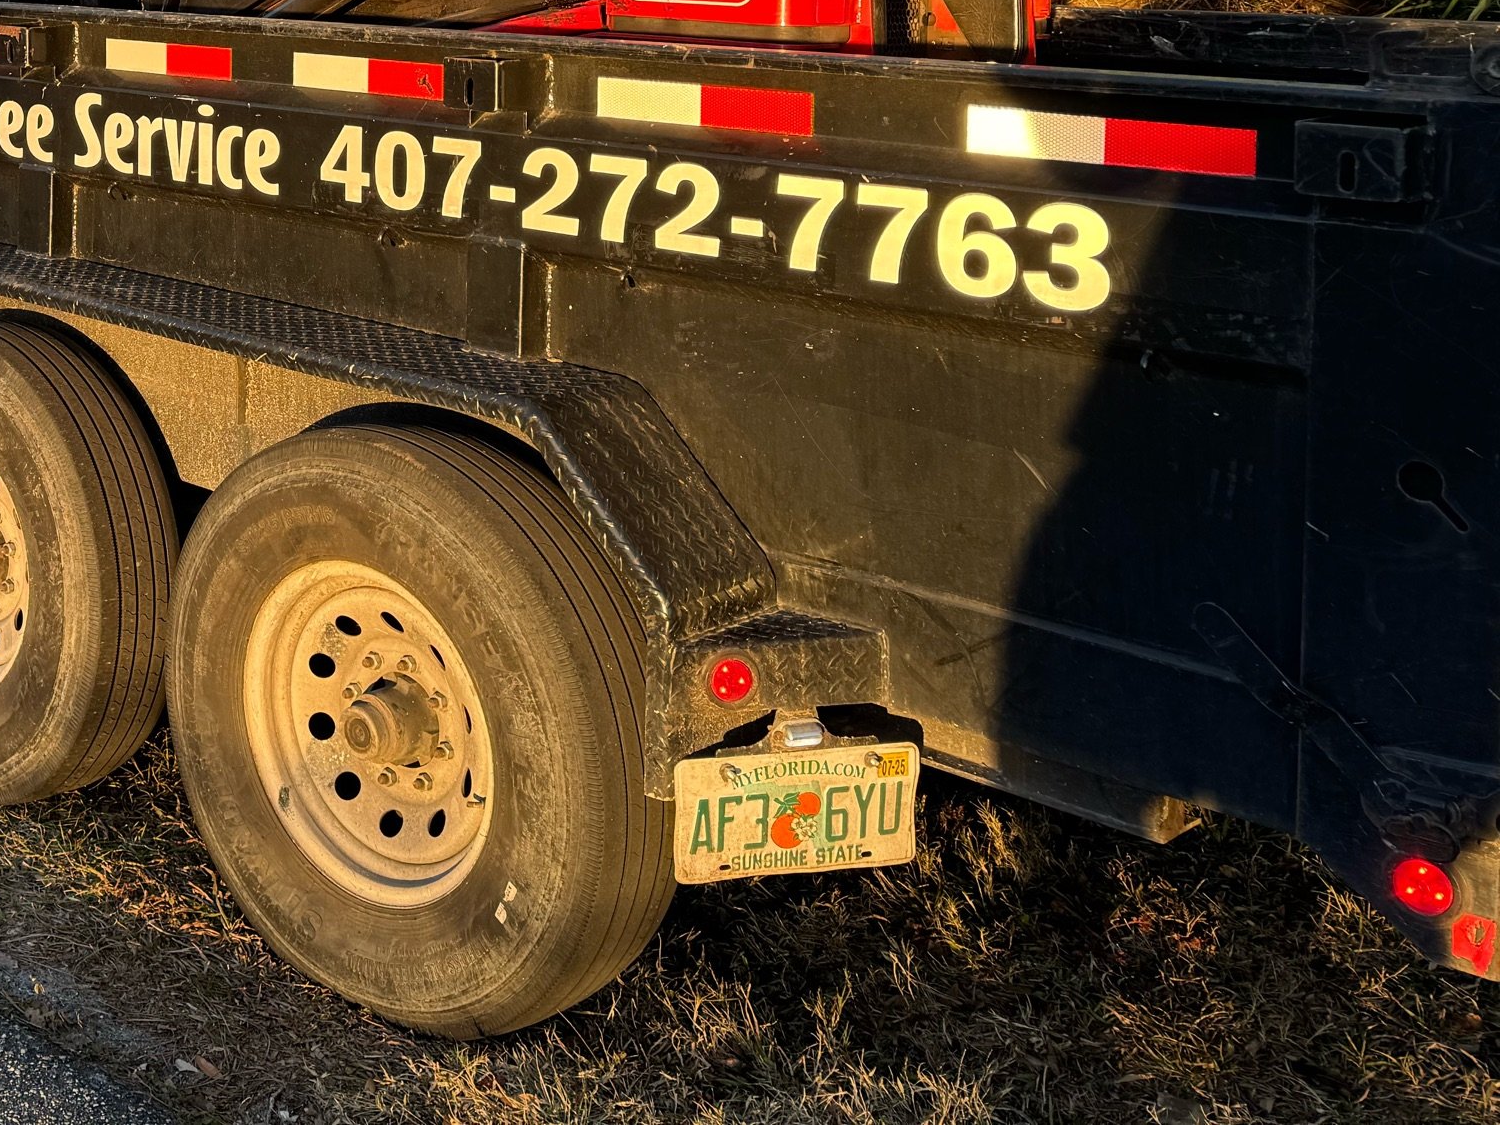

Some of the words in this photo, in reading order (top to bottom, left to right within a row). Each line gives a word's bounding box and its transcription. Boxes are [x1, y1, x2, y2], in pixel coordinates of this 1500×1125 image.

[74, 92, 281, 196] Service
[319, 124, 1113, 312] 407-272-7763
[881, 758, 906, 777] 07-25
[825, 780, 904, 844] 6YU
[731, 849, 808, 872] SUNSHINE
[815, 843, 864, 866] STATE
